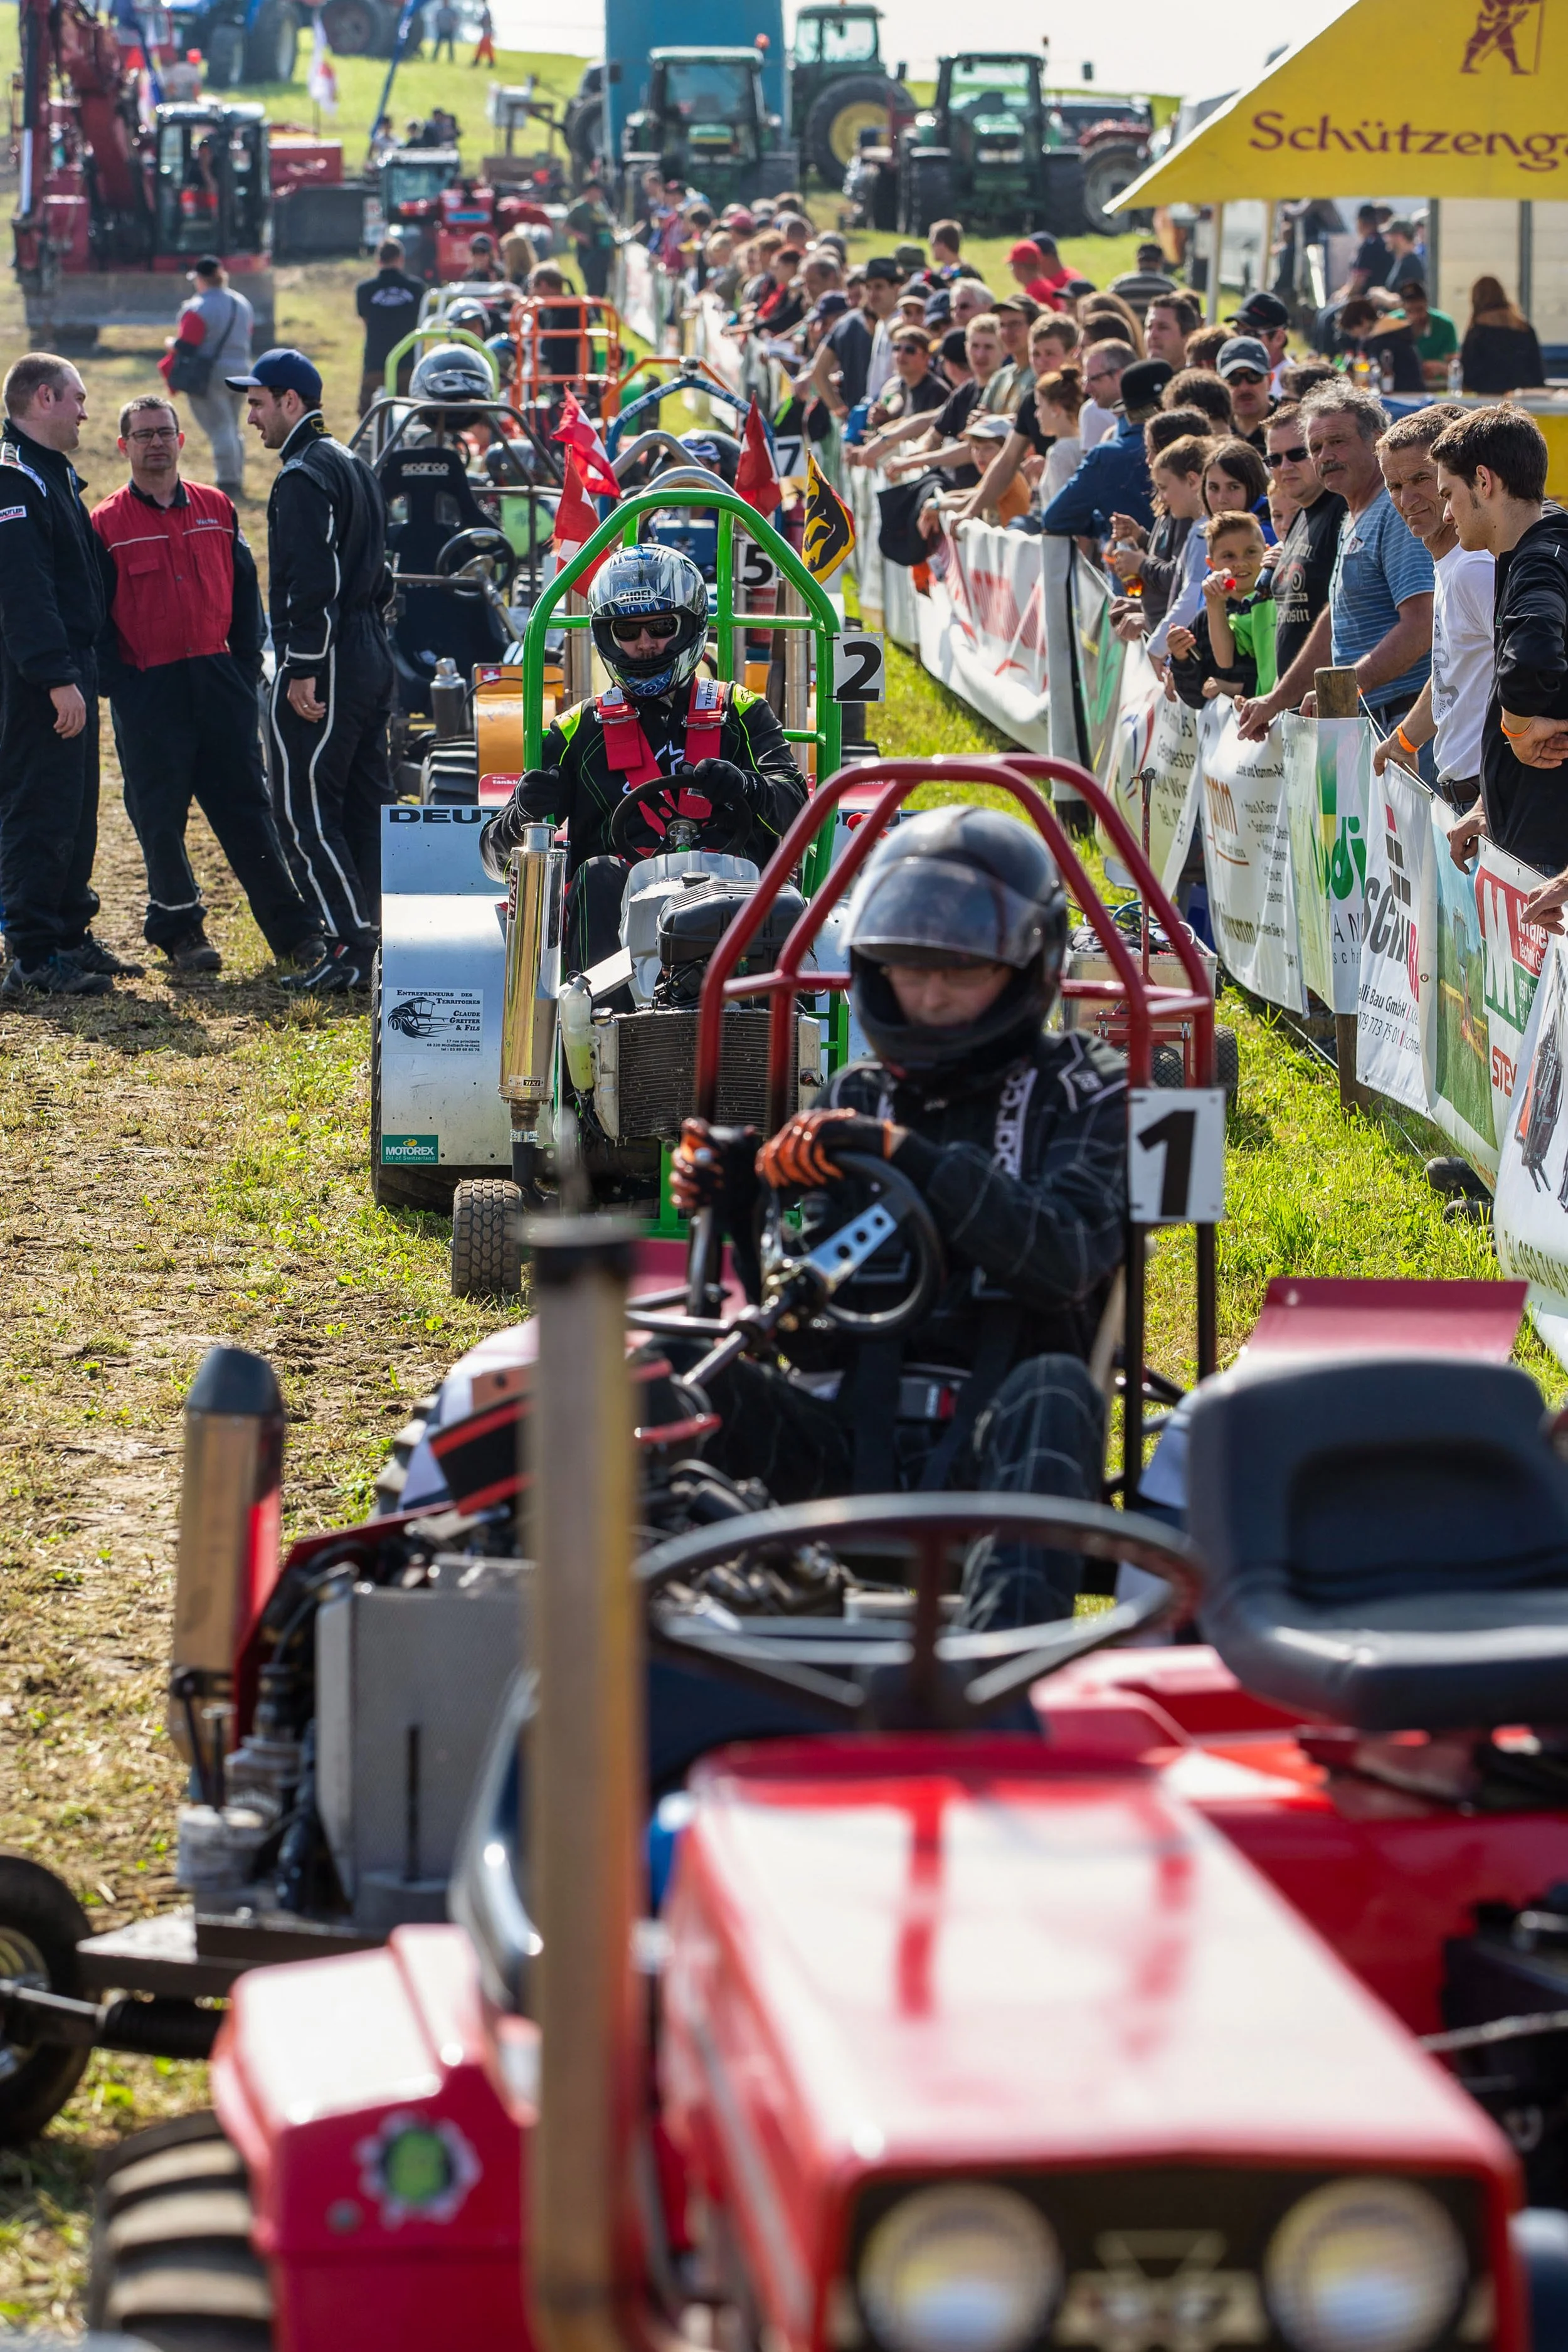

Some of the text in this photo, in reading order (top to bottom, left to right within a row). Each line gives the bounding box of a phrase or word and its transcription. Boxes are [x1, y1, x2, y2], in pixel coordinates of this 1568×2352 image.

[1249, 110, 1568, 172] Schützeng
[778, 443, 800, 476] 7
[743, 544, 773, 586] 5
[618, 590, 652, 603] SHOEI
[836, 641, 882, 701] 2
[389, 809, 501, 824] DEUT
[1369, 989, 1385, 1009] Bau
[1385, 996, 1407, 1019] GmbH
[1368, 1017, 1383, 1036] 773
[1382, 1023, 1393, 1041] 75
[386, 1147, 435, 1155] MOTOREX
[1137, 1110, 1196, 1217] 1
